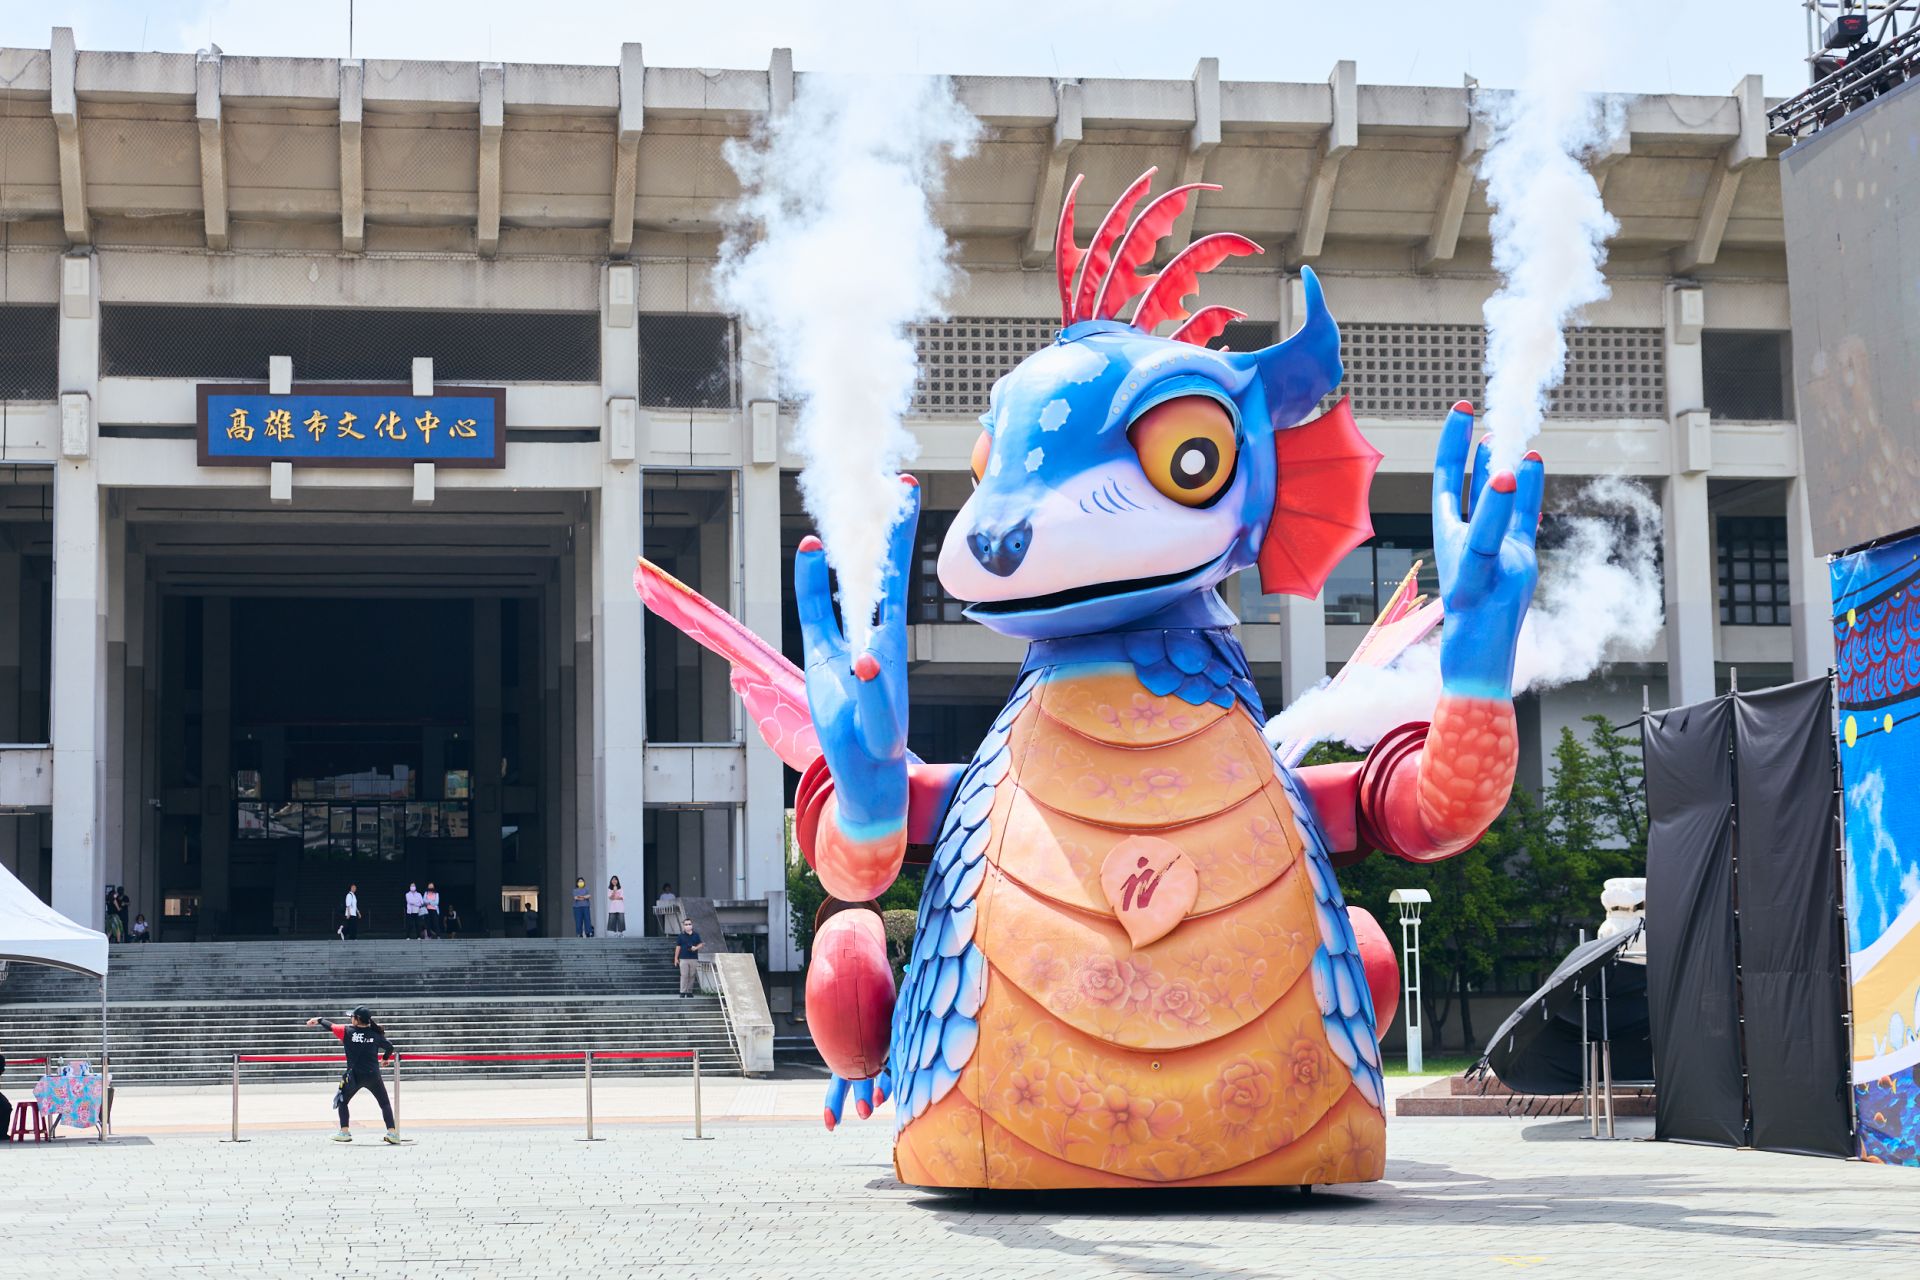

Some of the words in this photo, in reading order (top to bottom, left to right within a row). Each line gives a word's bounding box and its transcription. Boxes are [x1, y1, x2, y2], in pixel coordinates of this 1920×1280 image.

[226, 408, 477, 444] 高雄市文化中心
